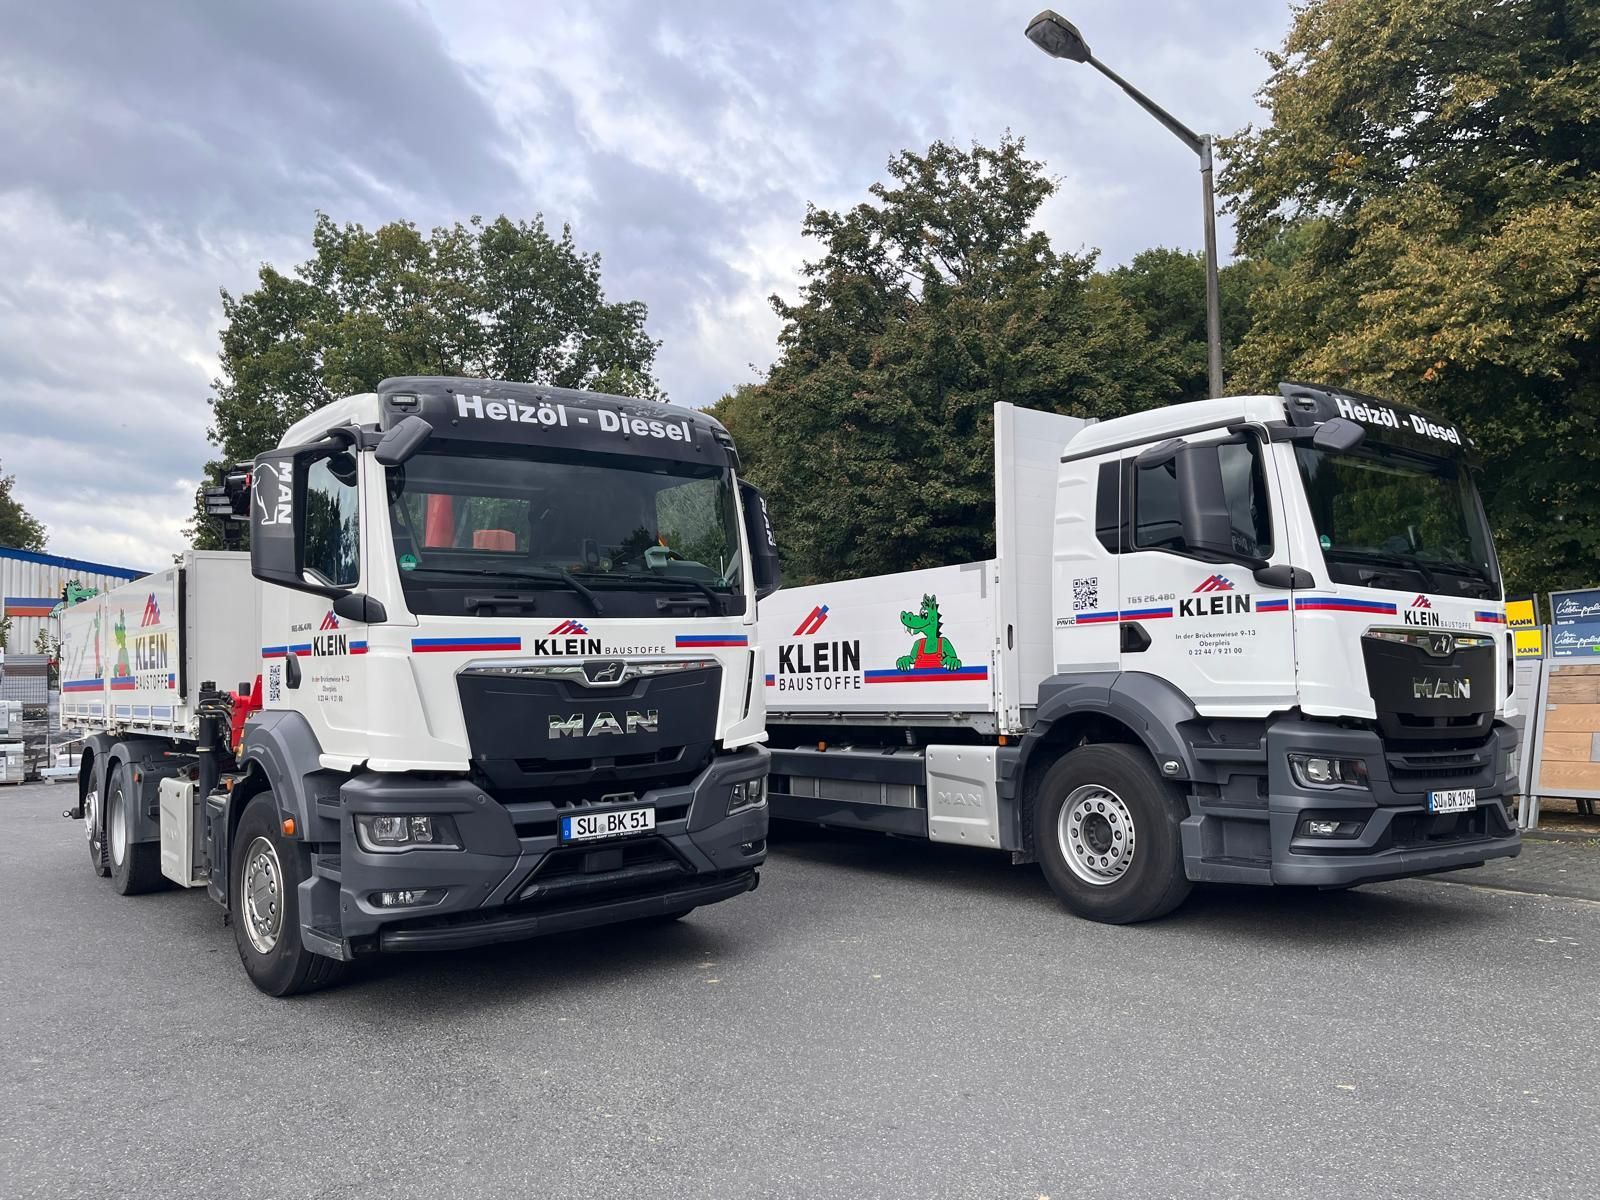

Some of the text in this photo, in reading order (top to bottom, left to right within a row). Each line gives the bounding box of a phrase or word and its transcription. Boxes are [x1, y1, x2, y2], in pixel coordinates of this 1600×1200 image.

[455, 394, 568, 427] Heizöl
[596, 409, 692, 443] Diesel
[1335, 398, 1400, 428] Heizöl
[1409, 413, 1461, 445] Diesel
[278, 461, 292, 524] MAN
[1144, 593, 1175, 602] 26.480
[1179, 594, 1251, 617] KLEIN
[1404, 610, 1471, 630] KLEIN BAUSTOFFE
[1509, 618, 1533, 626] KANN
[136, 633, 168, 671] KLEIN
[313, 634, 347, 656] KLEIN
[535, 638, 666, 656] KLEIN BAUSTOFFE
[778, 639, 860, 674] KLEIN
[136, 673, 168, 690] BAUSTOFFE
[779, 675, 861, 691] BAUSTOFFE
[1413, 677, 1471, 699] MAN
[548, 709, 659, 740] MAN
[938, 791, 983, 808] MAN
[1433, 790, 1475, 808] SU BK 1964
[577, 817, 597, 835] SU
[607, 813, 628, 832] BK
[630, 811, 649, 829] 51
